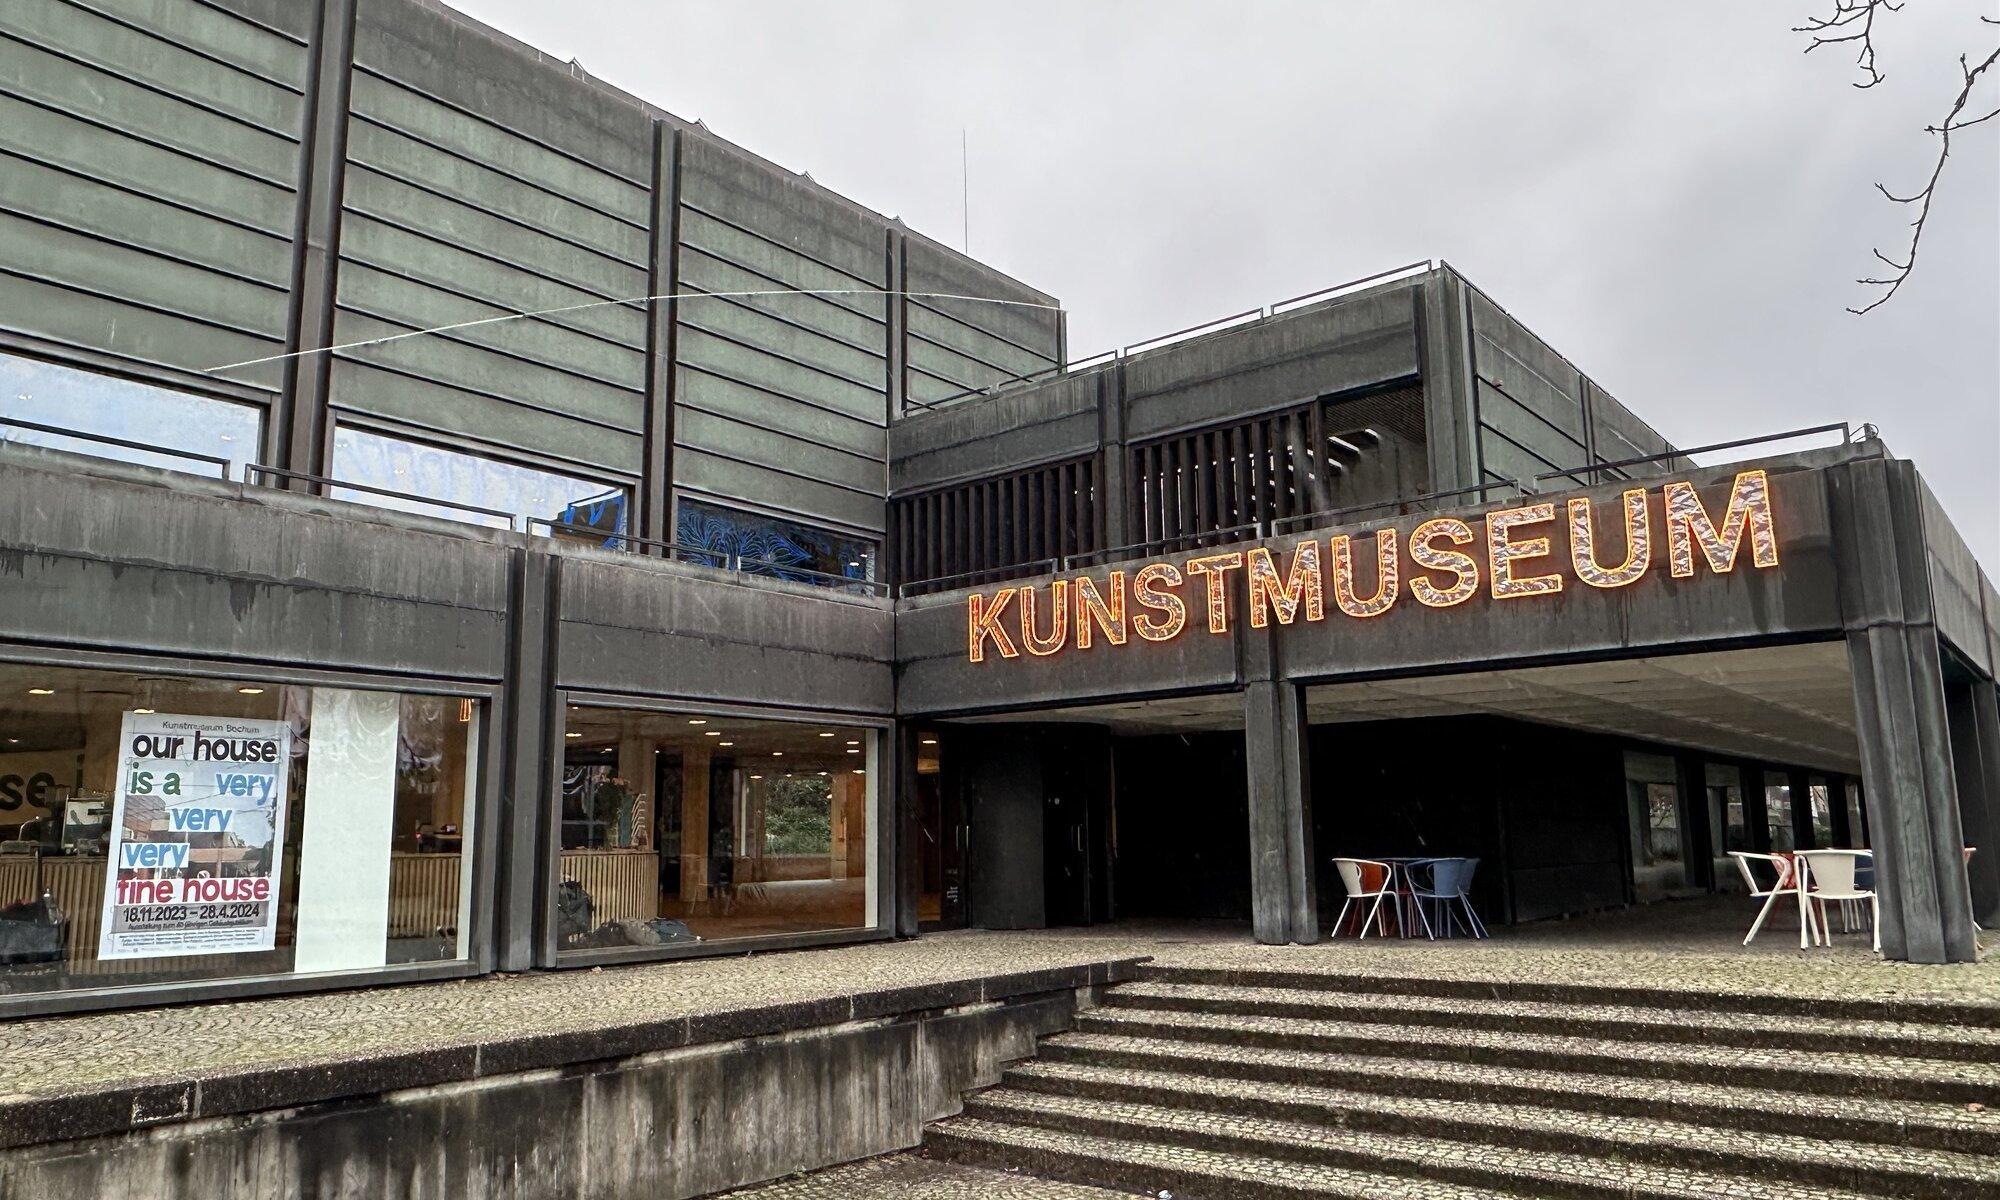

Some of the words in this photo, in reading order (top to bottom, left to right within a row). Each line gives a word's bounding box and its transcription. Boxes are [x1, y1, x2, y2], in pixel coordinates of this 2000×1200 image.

[967, 469, 1781, 663] KUNSTMUSEUM
[226, 725, 259, 733] Bochum
[132, 735, 185, 759] our
[192, 730, 277, 762] house
[130, 762, 153, 795] is
[162, 772, 181, 795] a
[216, 773, 274, 806] very
[171, 808, 232, 832] very
[125, 844, 189, 869] very
[182, 874, 270, 902] house
[123, 906, 187, 922] 18.11.2023
[200, 904, 260, 919] 28.4.2024
